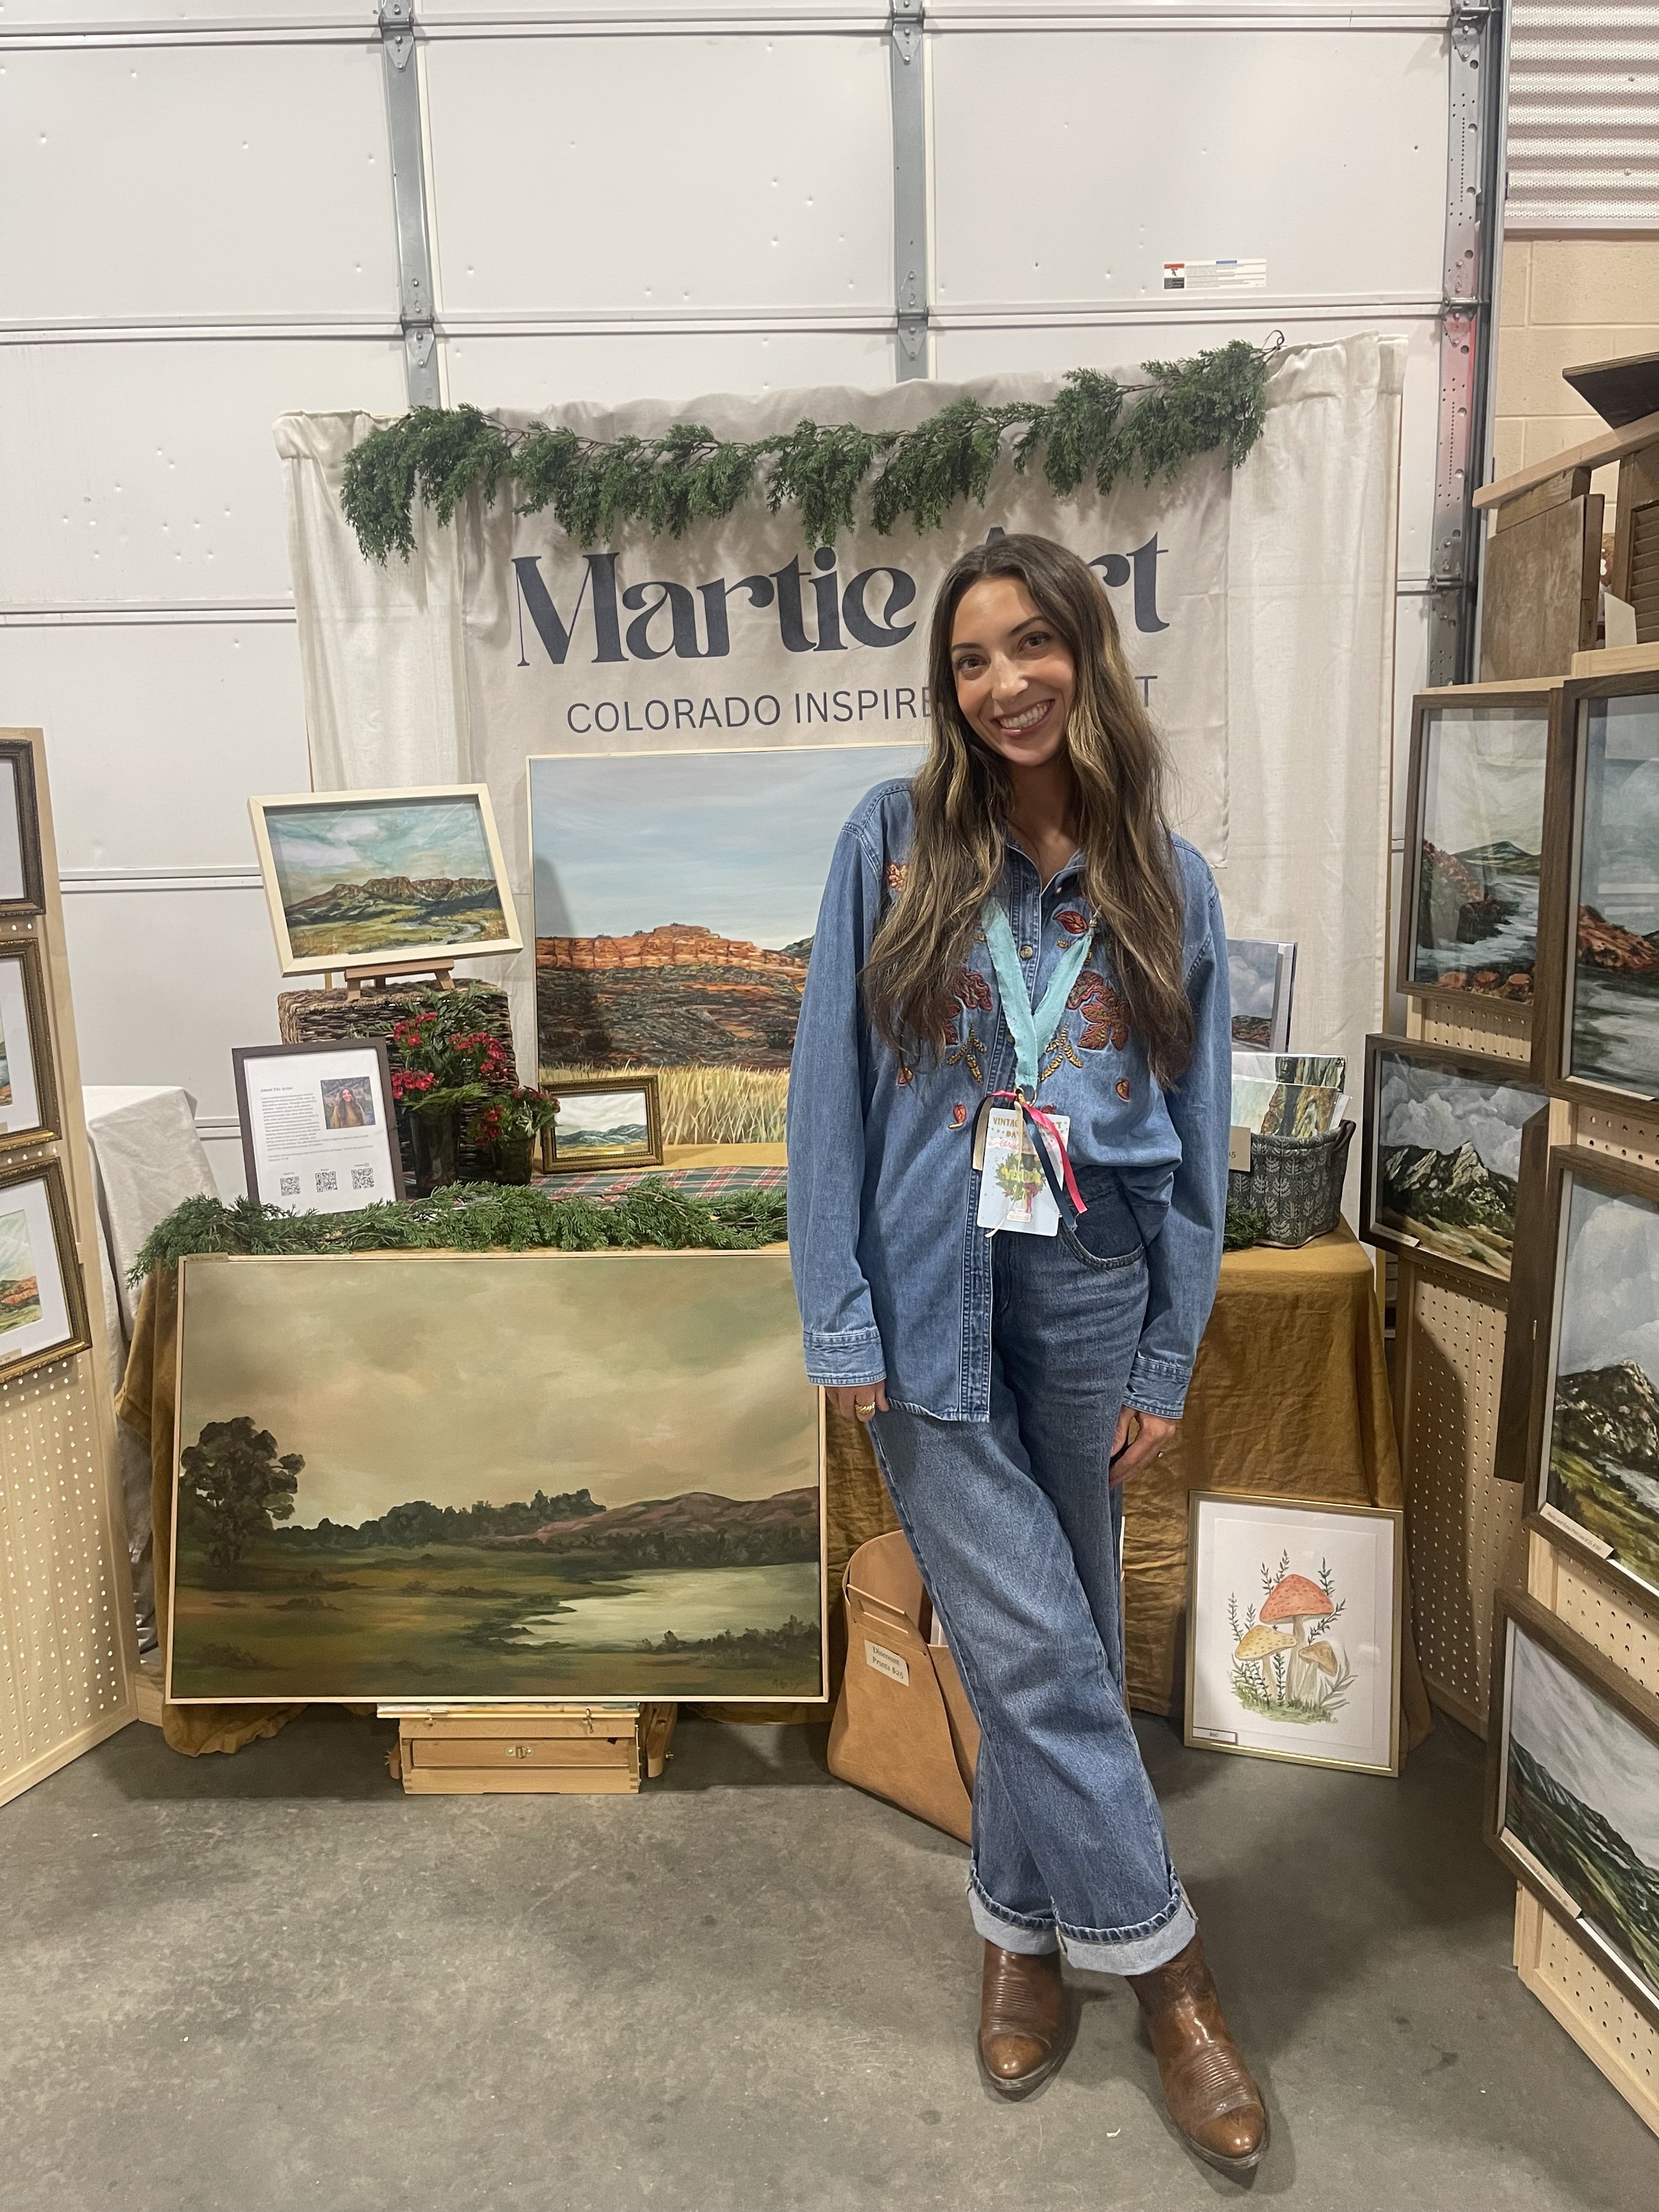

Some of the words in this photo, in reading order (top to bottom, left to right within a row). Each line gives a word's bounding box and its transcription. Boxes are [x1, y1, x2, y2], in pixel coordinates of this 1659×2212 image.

[511, 546, 917, 666] Martie
[567, 695, 780, 733] COLORADO
[872, 1656, 891, 1671] Prints
[892, 1666, 904, 1679] $25
[873, 1647, 899, 1666] Discount
